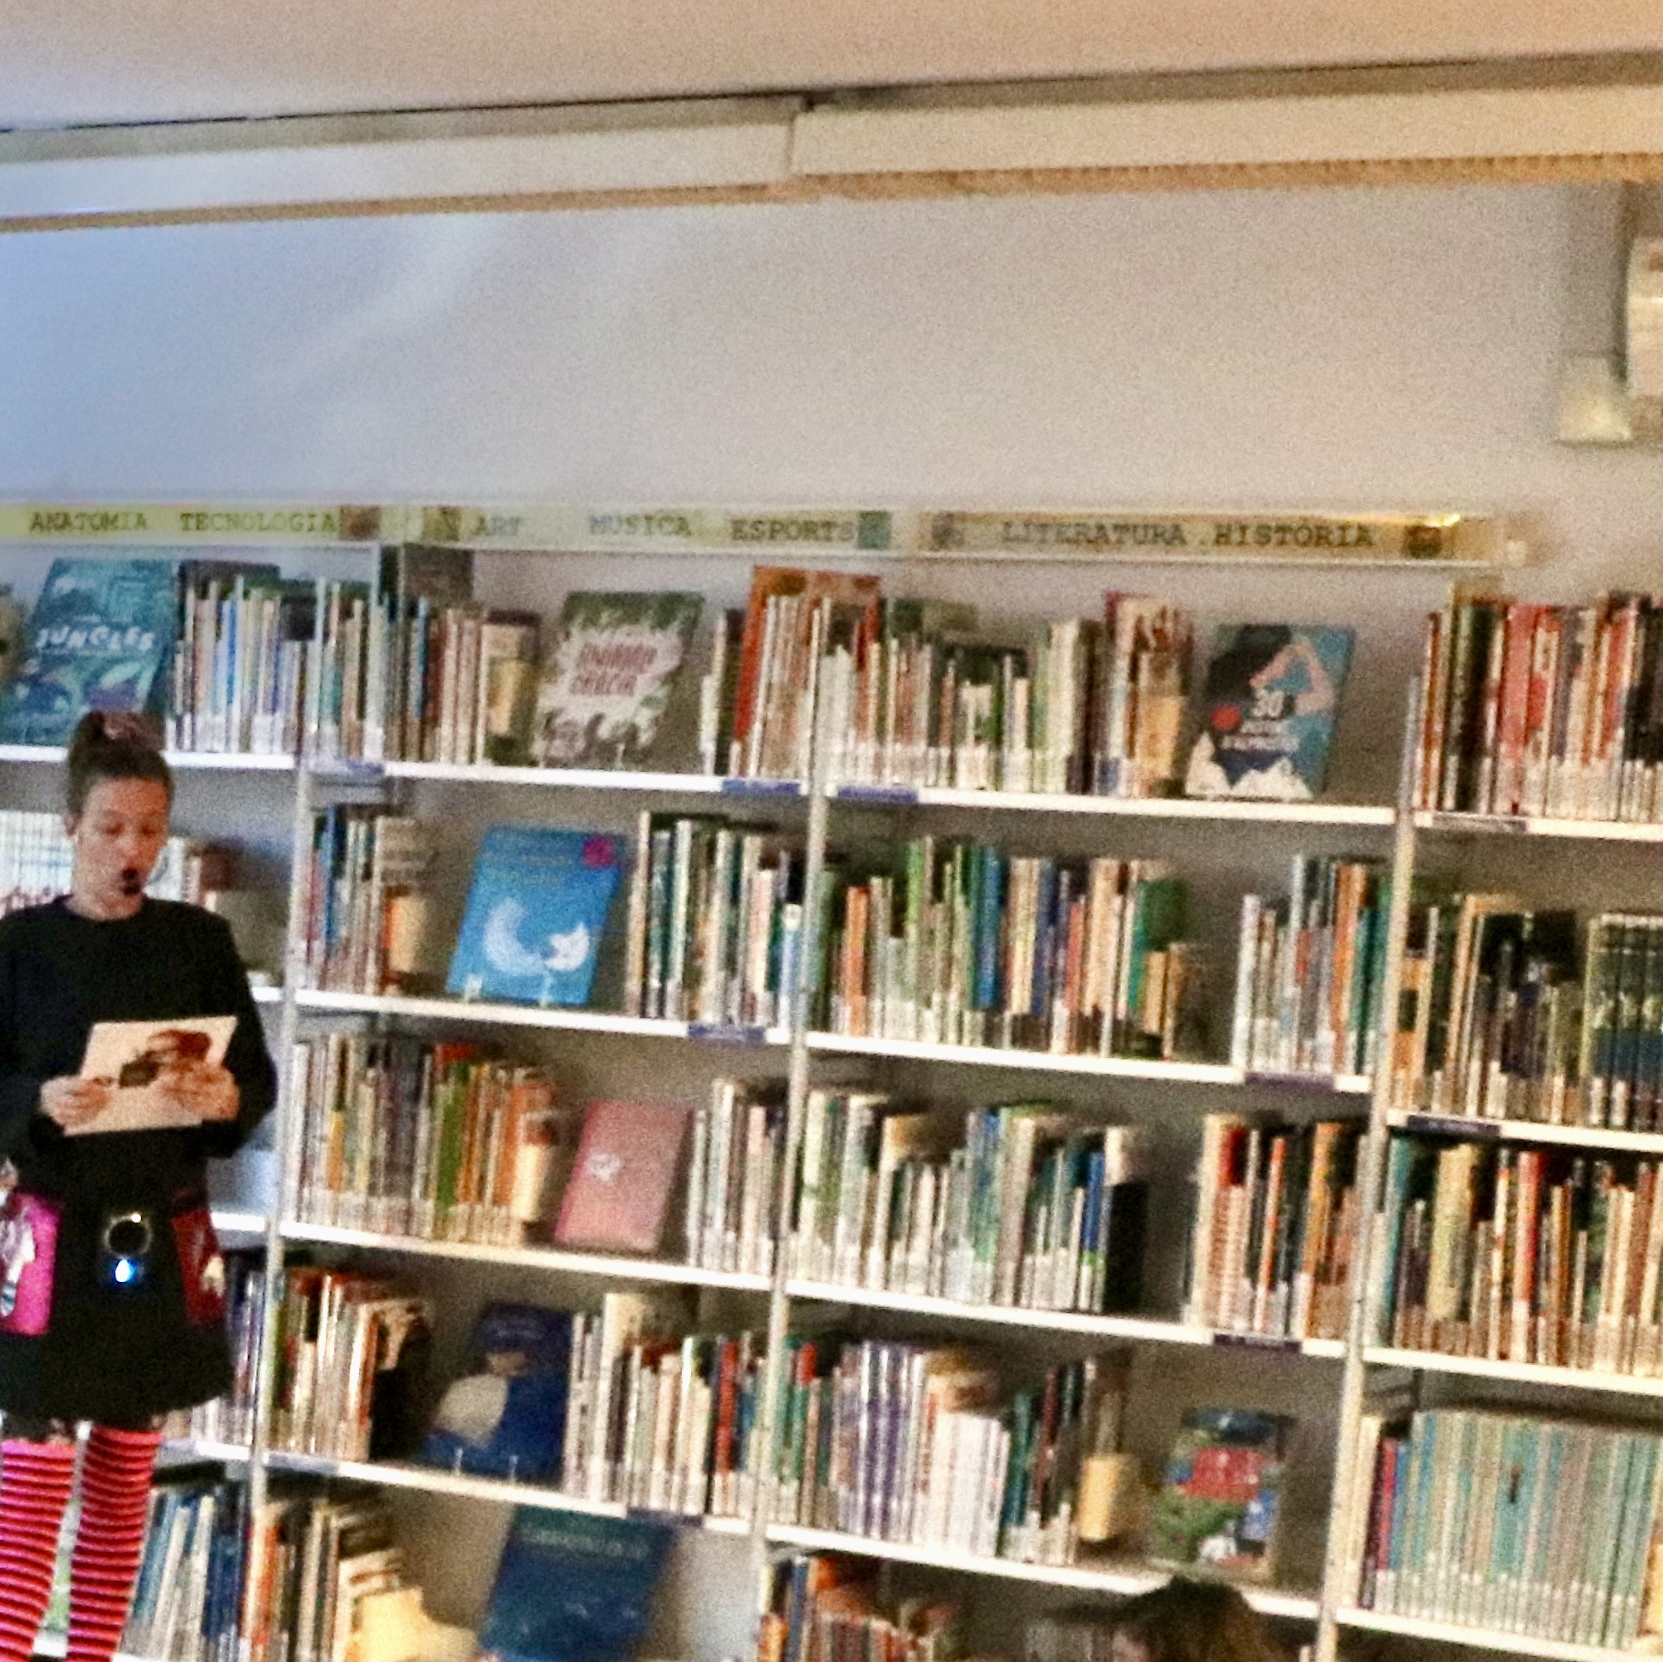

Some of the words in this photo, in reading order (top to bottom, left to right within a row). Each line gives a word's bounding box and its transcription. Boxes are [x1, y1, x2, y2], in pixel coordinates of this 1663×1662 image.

[28, 511, 148, 533] ANATOMIA
[180, 511, 339, 533] TECNOLOGIA
[731, 517, 854, 542] ESPORTS
[1002, 522, 1188, 547] LITERATURA
